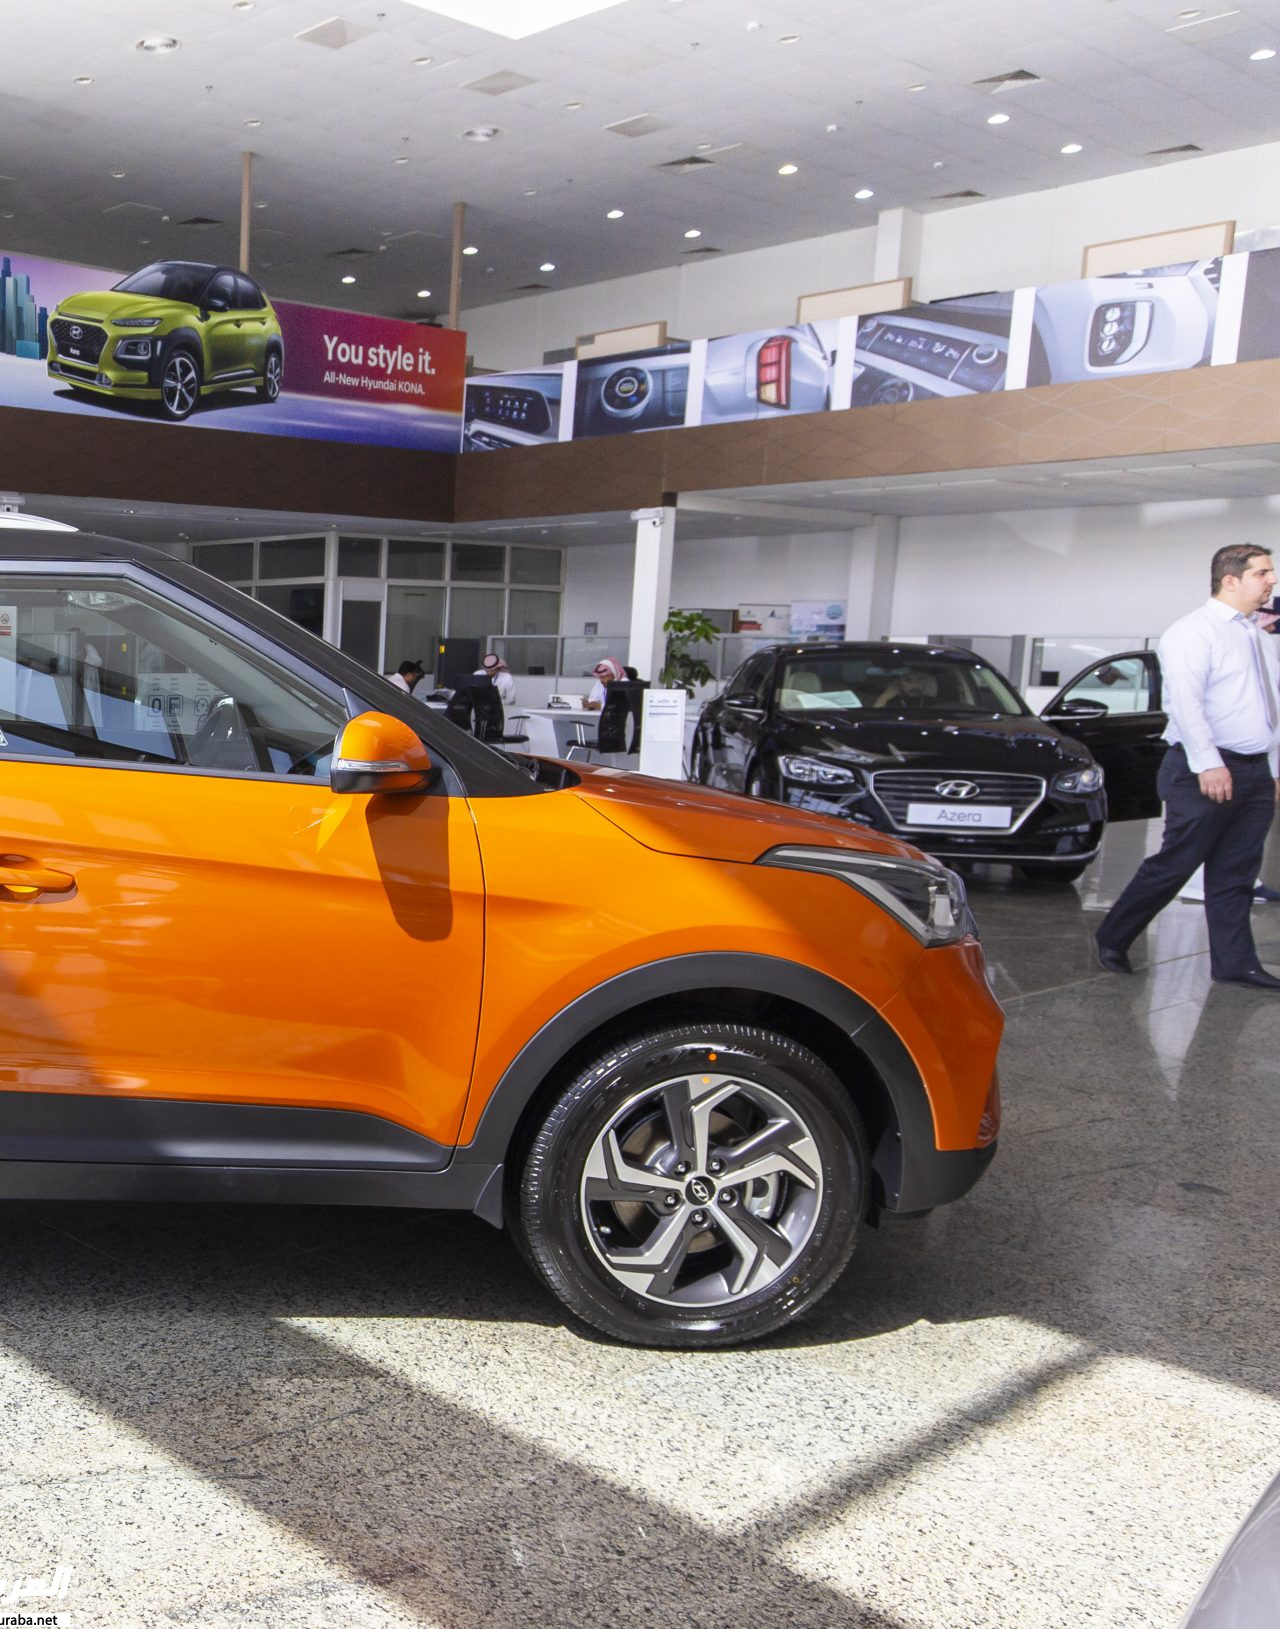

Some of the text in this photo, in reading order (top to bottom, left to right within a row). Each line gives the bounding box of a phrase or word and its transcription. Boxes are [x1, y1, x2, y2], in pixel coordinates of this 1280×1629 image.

[323, 334, 436, 375] You style it.
[323, 371, 426, 395] All-New Hyundai KONA.
[937, 809, 983, 823] Azera
